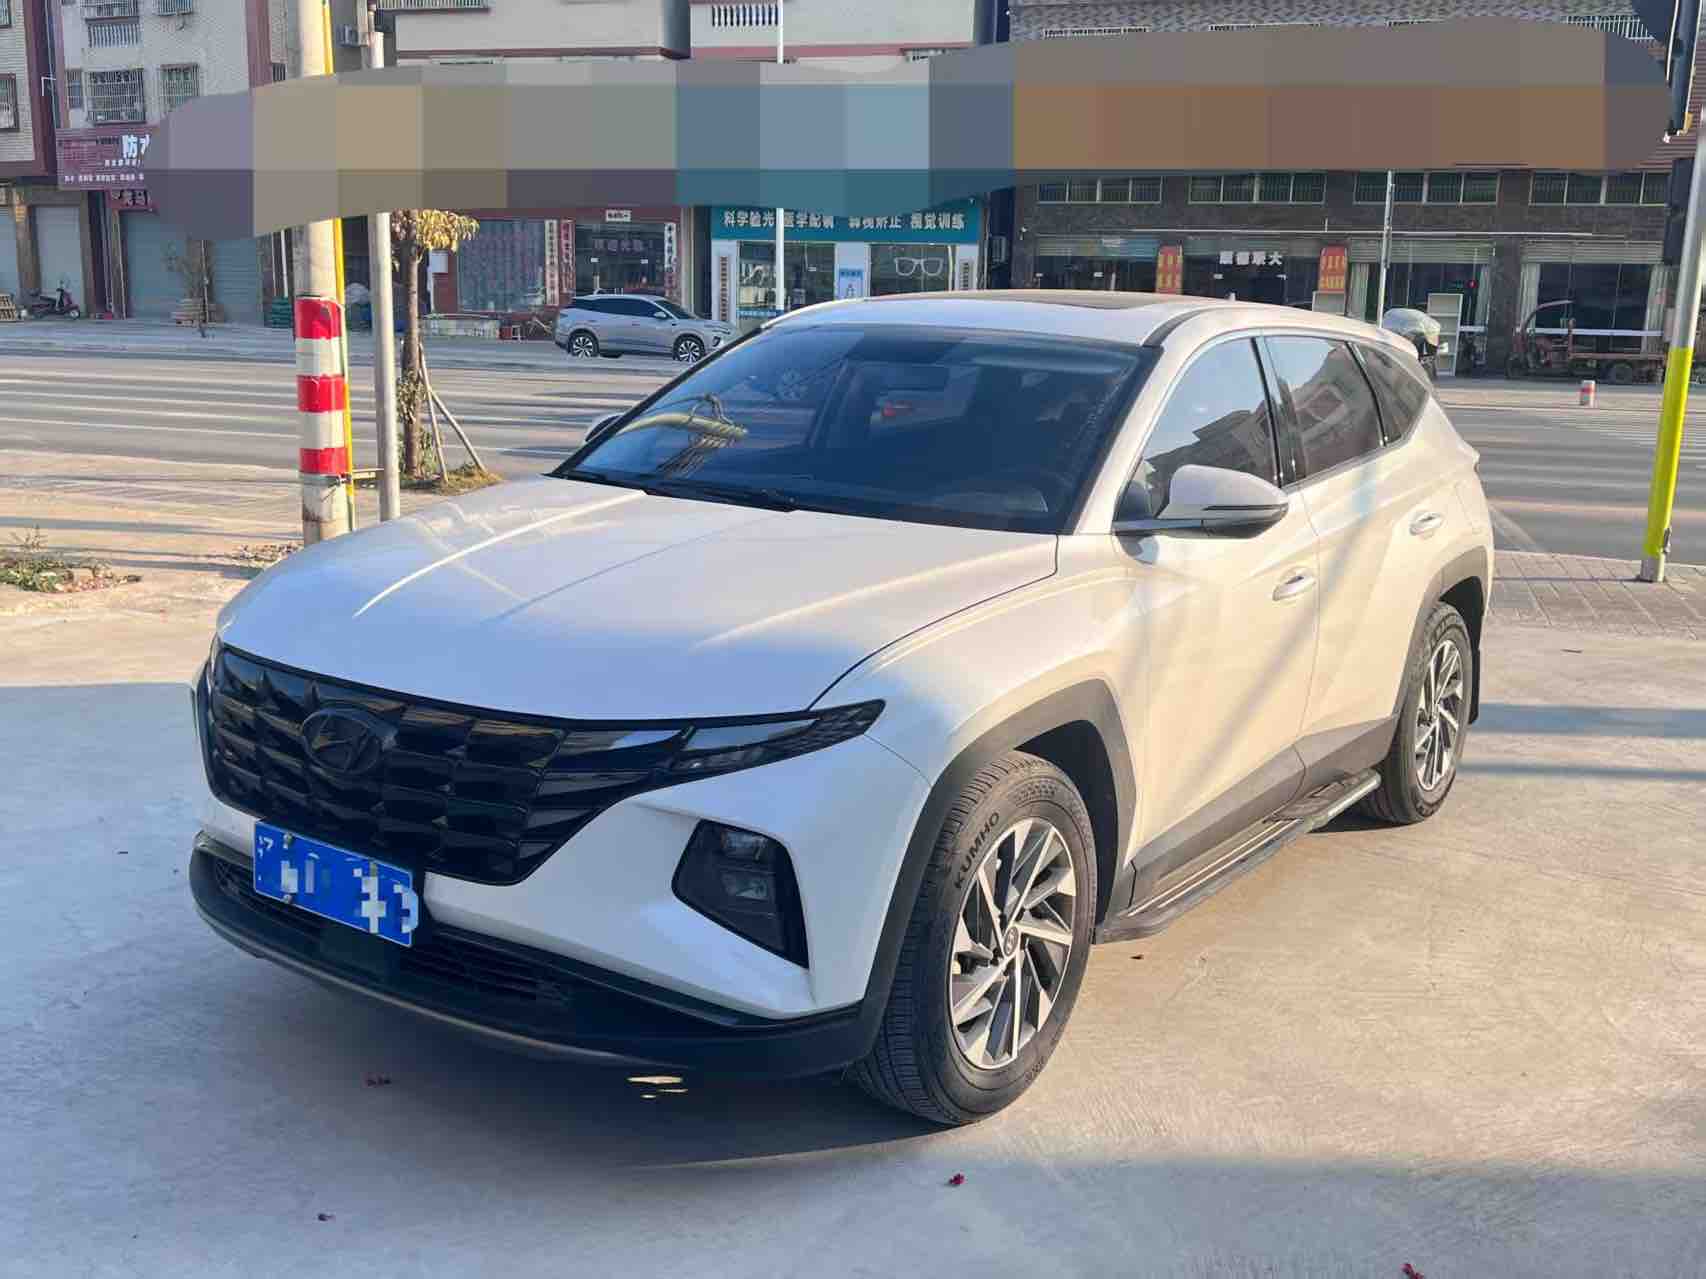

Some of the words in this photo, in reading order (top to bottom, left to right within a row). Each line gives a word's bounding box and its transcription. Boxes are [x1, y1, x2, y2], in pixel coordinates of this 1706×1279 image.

[911, 210, 966, 229] 视觉训练
[954, 812, 1000, 889] KUMHO
